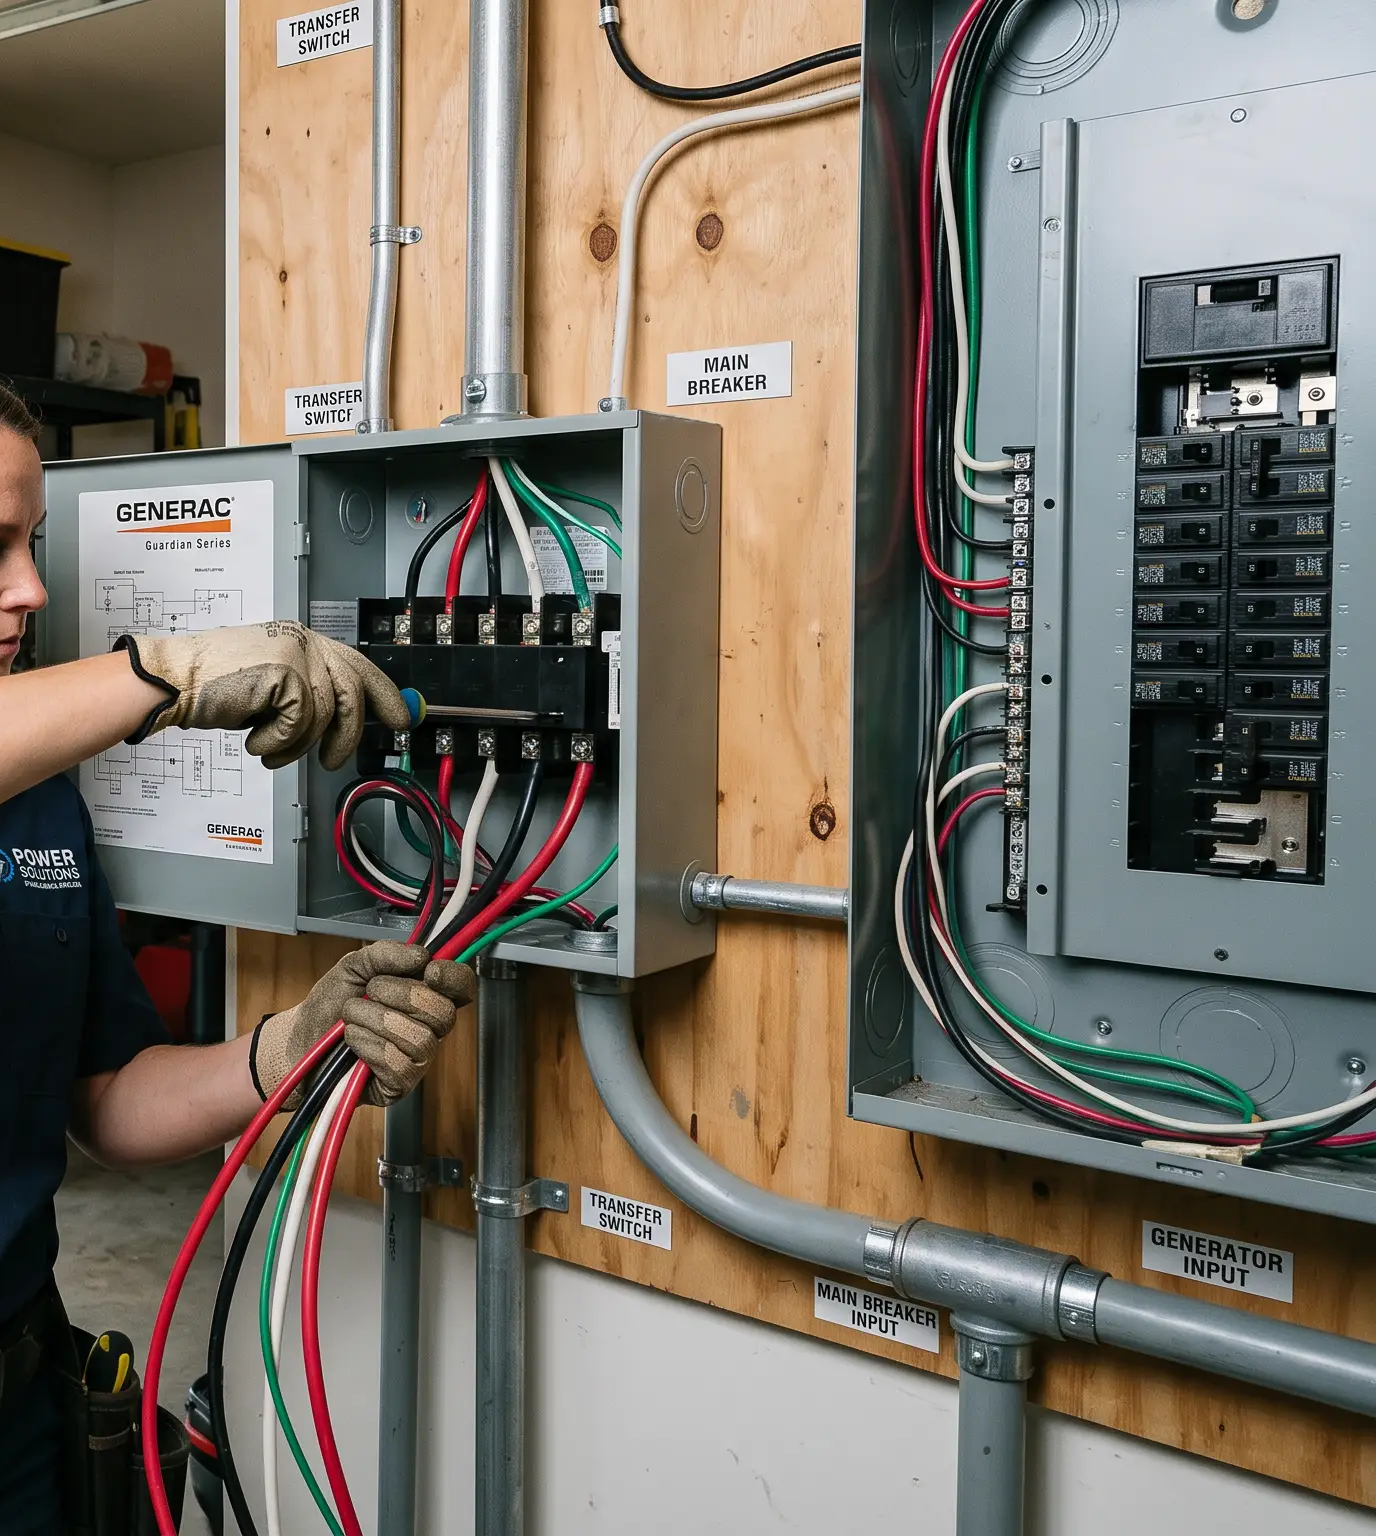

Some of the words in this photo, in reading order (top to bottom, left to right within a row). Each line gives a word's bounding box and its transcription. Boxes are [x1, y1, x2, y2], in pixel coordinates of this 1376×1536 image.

[289, 6, 360, 38] TRANSFER
[298, 29, 350, 55] SWITCH
[704, 353, 749, 373] MAIN
[294, 389, 363, 408] TRANSFER
[687, 374, 767, 396] BREAKER
[145, 540, 192, 551] Guardian
[196, 538, 231, 550] Series
[11, 847, 76, 867] POWER
[19, 865, 81, 881] SOLUTIONS
[589, 1192, 662, 1226] TRANSFER
[599, 1212, 652, 1241] SWITCH
[1151, 1227, 1283, 1274] GENERATOR
[1183, 1256, 1250, 1287] INPUT
[817, 1282, 857, 1307] MAIN
[863, 1294, 937, 1330] BREAKER
[851, 1309, 899, 1337] INPUT
